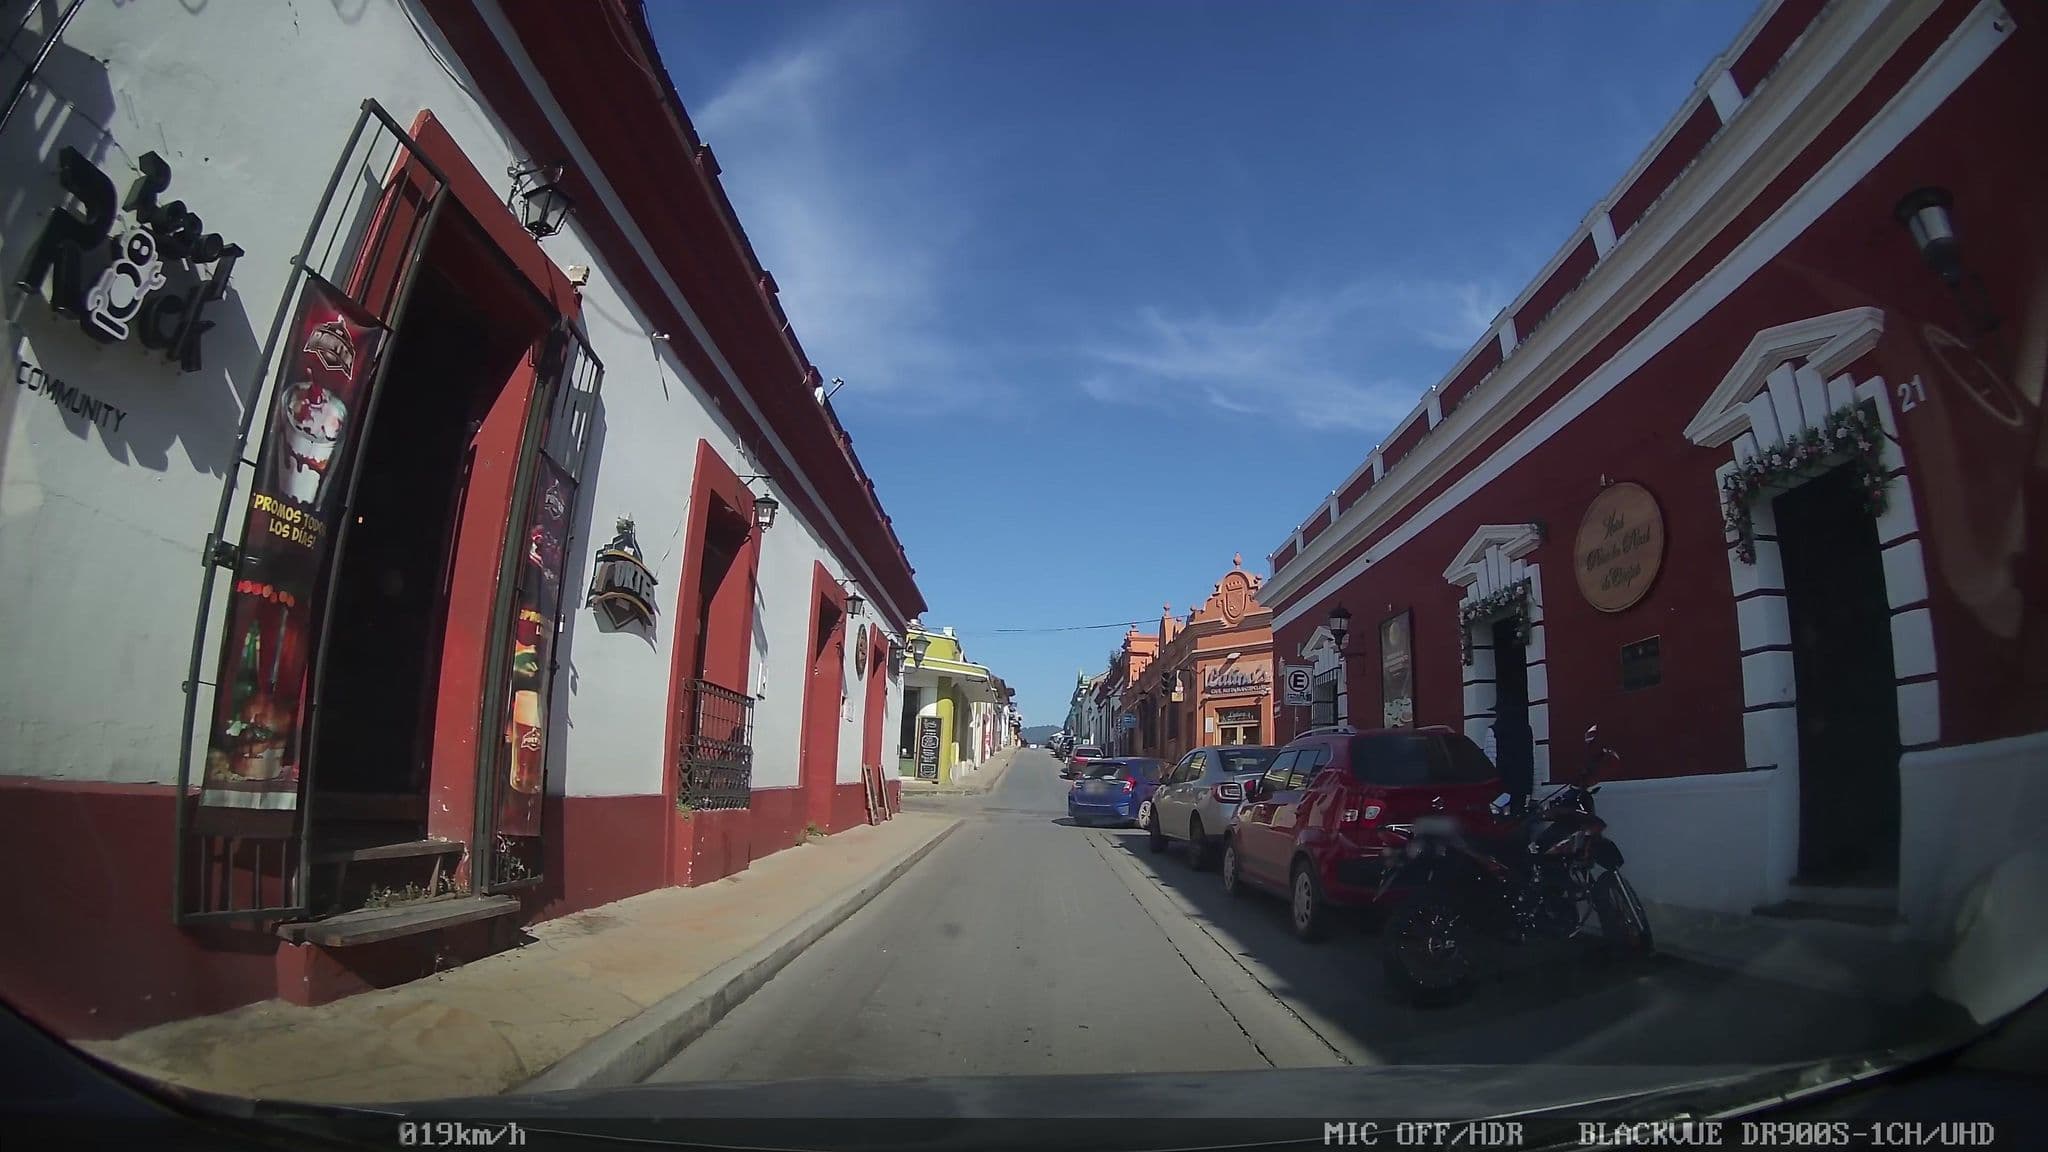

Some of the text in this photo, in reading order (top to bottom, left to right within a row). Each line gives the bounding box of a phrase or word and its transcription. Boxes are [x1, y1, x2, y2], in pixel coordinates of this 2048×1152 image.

[15, 361, 129, 432] COMMUNITY
[1897, 374, 1926, 413] 21
[268, 518, 291, 539] LOS
[1293, 674, 1305, 688] E
